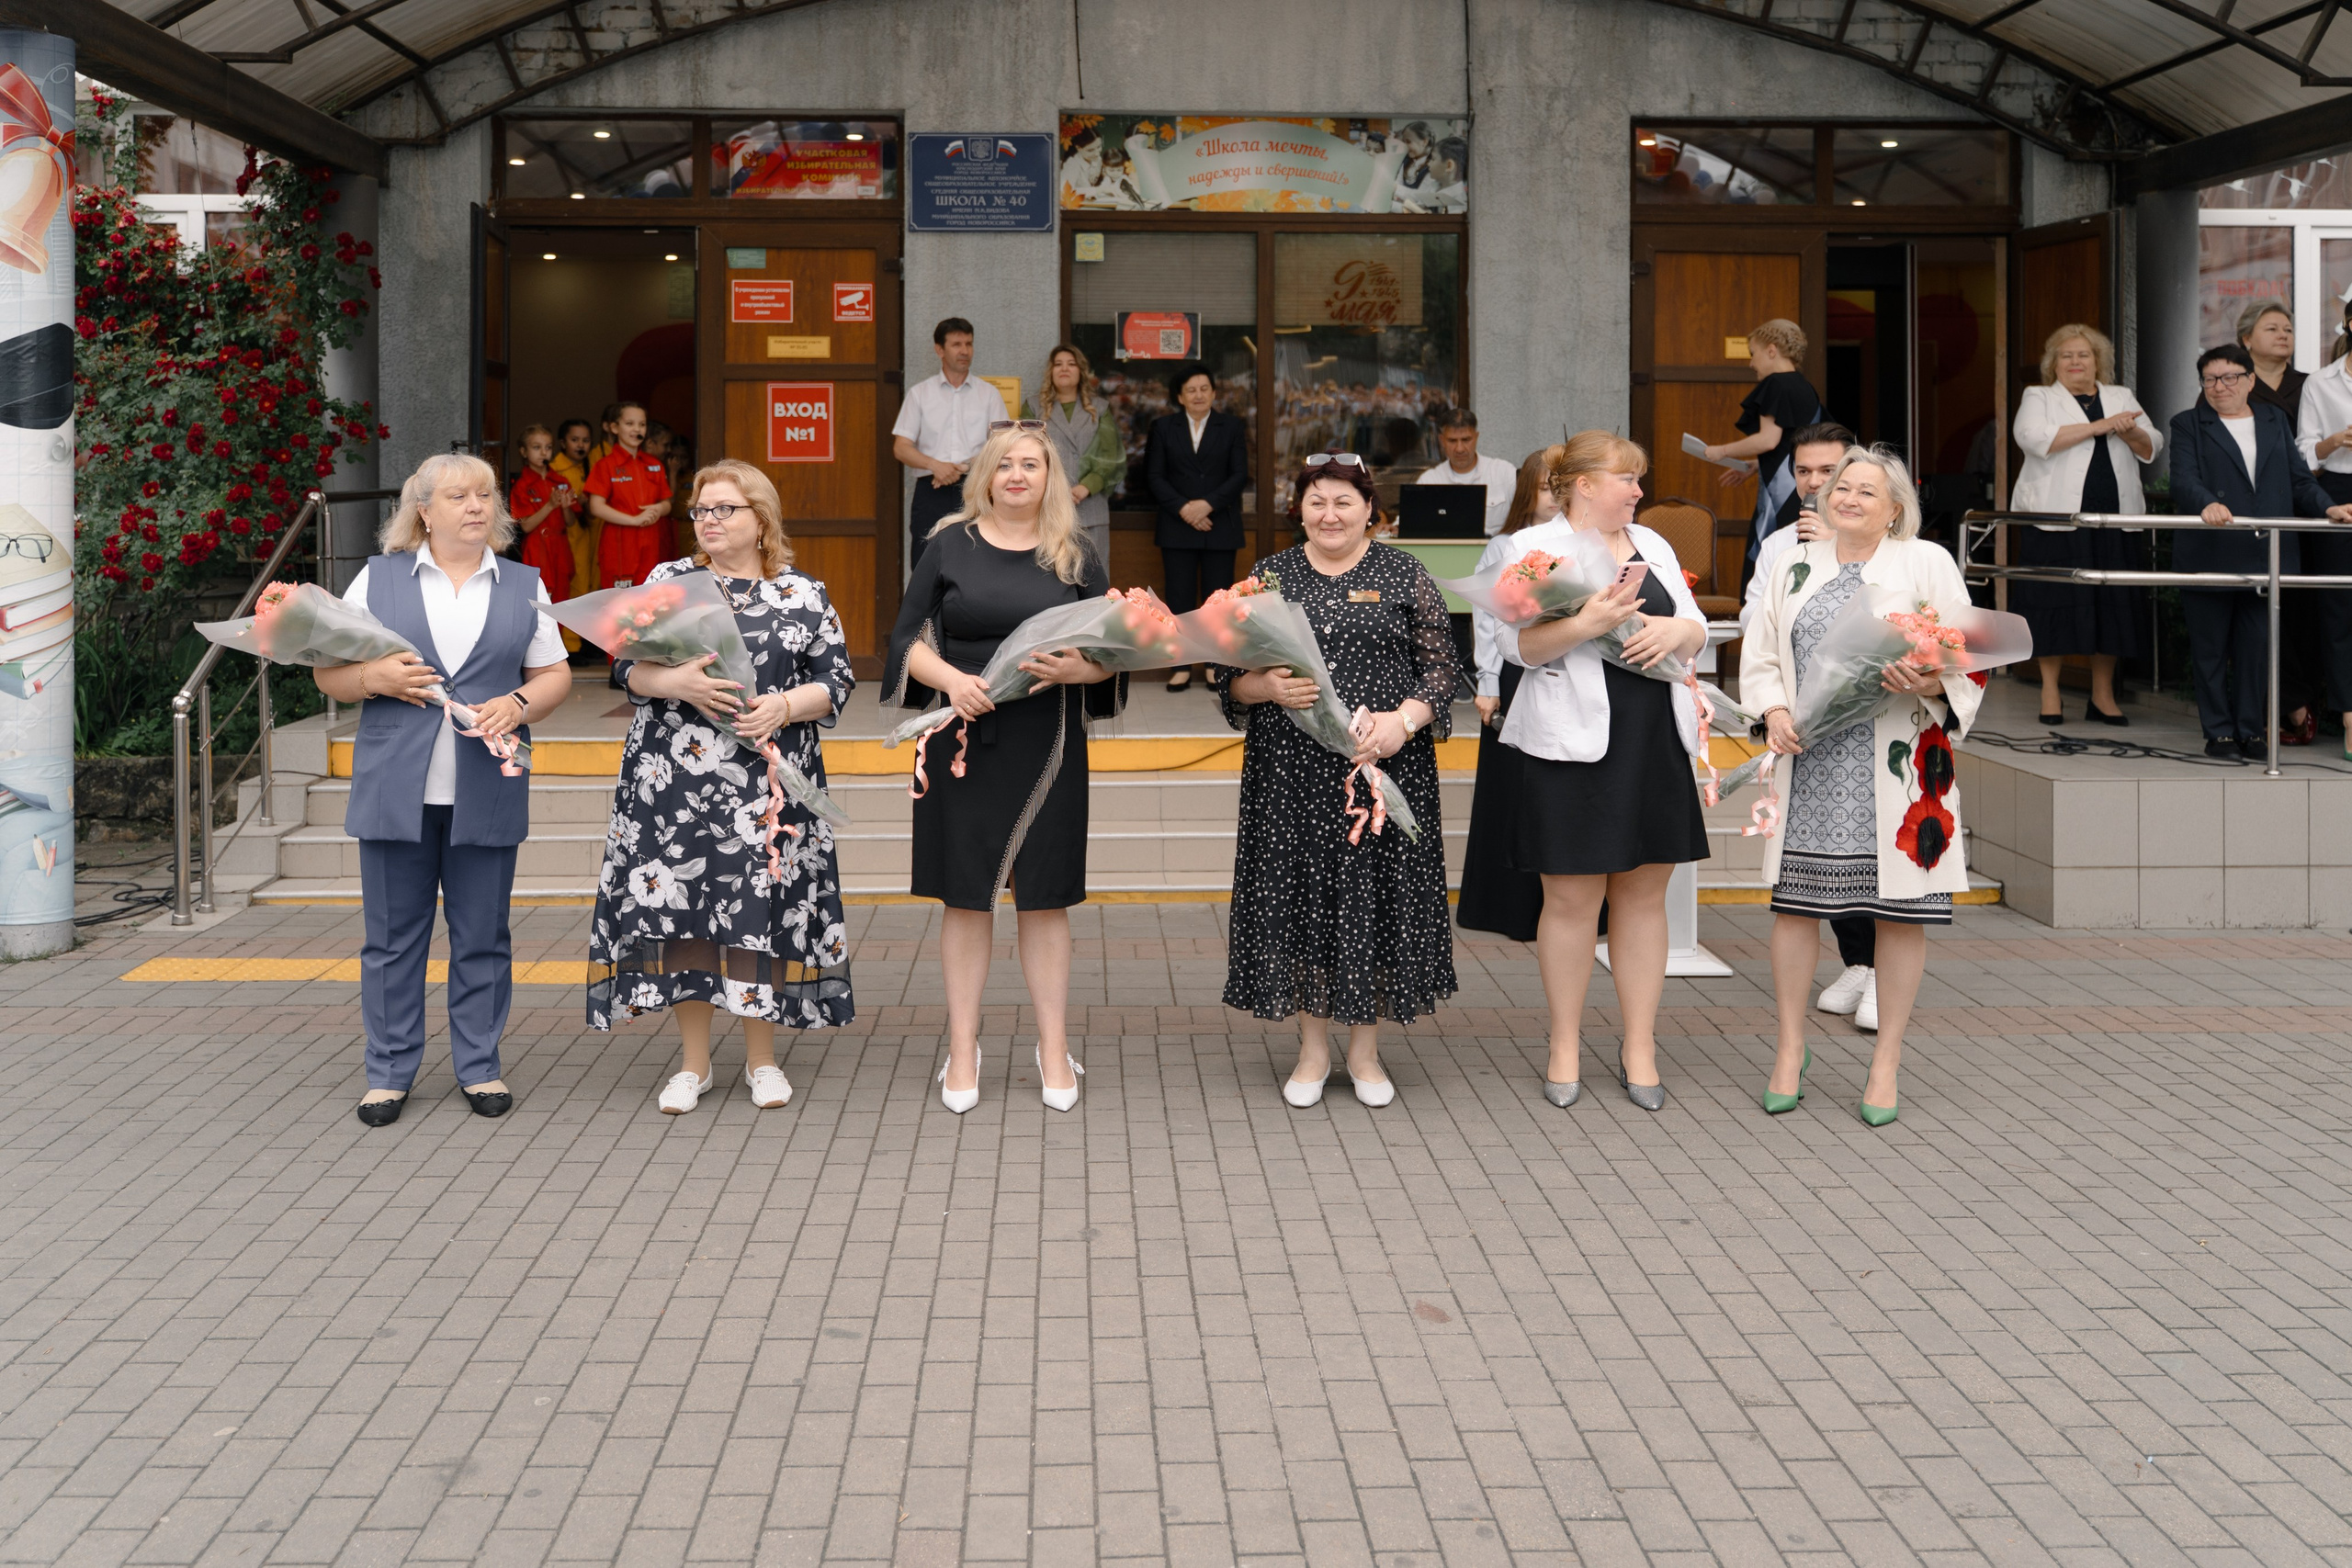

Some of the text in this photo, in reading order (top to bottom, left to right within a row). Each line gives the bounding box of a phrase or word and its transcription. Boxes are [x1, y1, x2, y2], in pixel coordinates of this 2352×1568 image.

[796, 149, 867, 158] УЧАСТКОВАЯ
[1195, 138, 1329, 162] «Школа мечты,
[786, 161, 876, 170] ИЗБИРАТЕЛЬНАЯ
[1188, 163, 1350, 186] надежды и свершений!»
[935, 196, 1027, 206] ШКОЛА № 40
[1334, 260, 1367, 301] 9
[1330, 300, 1397, 324] мая
[774, 402, 828, 420] ВХОД
[786, 426, 816, 442] №1
